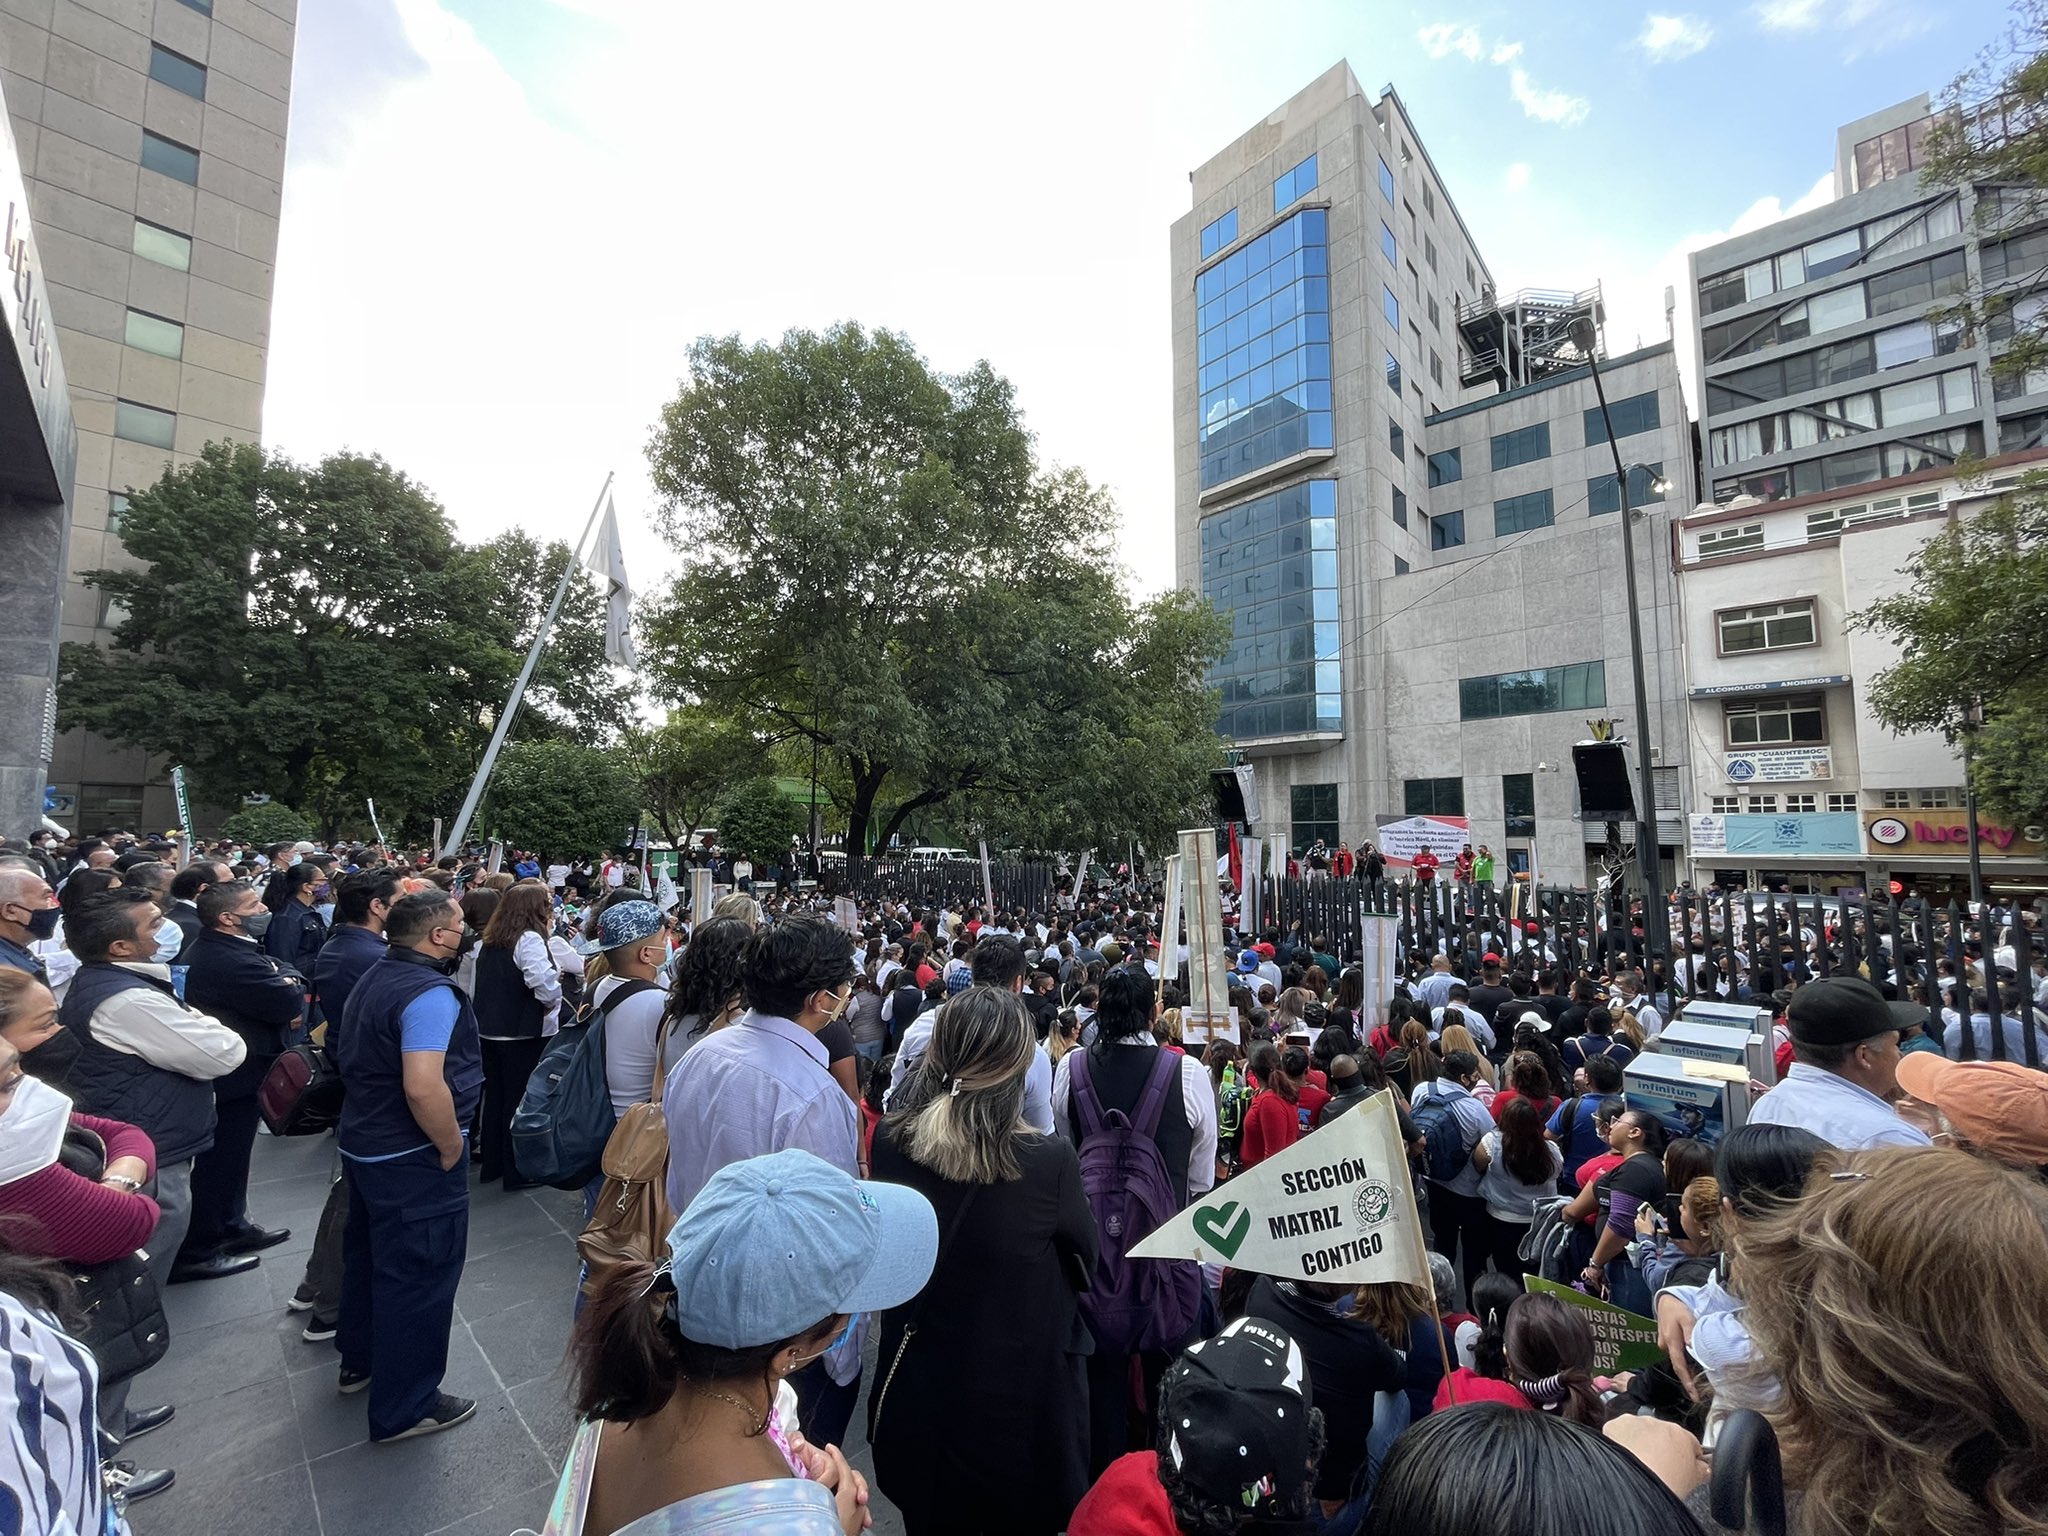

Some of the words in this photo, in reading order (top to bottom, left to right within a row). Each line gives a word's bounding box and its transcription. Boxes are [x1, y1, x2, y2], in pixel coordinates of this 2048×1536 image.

[1671, 1046, 1722, 1060] infinitum
[1637, 1080, 1698, 1099] infinitum
[1281, 1157, 1367, 1196] SECCIÓN
[1268, 1205, 1343, 1240] MATRIZ
[1301, 1232, 1384, 1277] CONTIGO
[1579, 1308, 1628, 1326] NISTAS
[1243, 1325, 1286, 1349] STRM
[1609, 1326, 1658, 1344] RESPET
